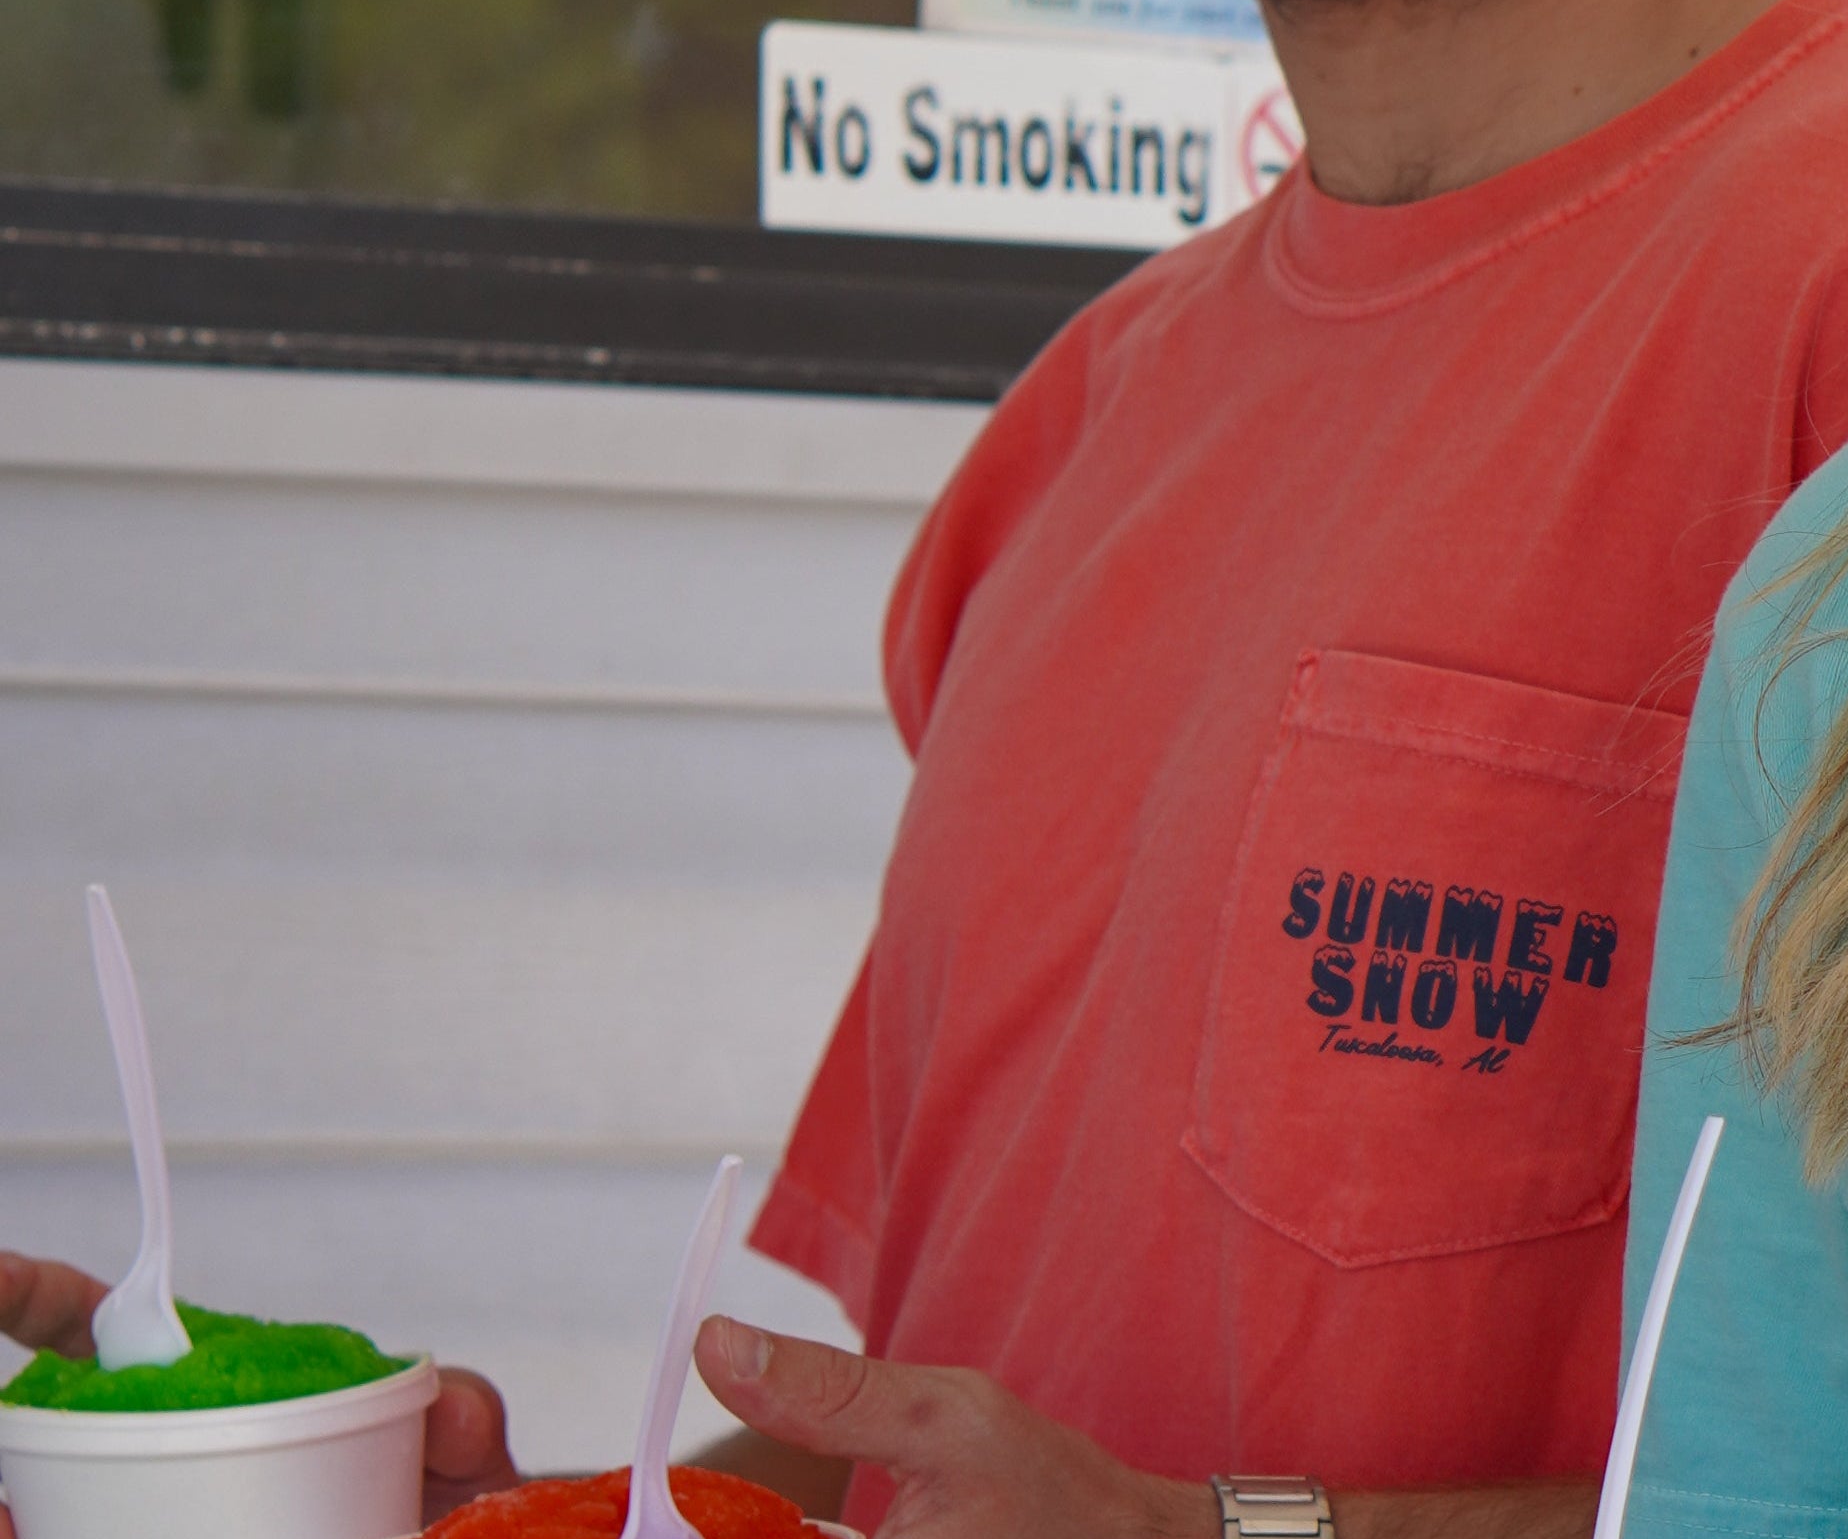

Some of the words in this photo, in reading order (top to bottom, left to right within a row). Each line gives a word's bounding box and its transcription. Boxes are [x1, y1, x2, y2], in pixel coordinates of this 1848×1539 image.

[780, 74, 871, 178] No
[903, 84, 1212, 226] Smoking
[1282, 867, 1618, 989] SUMMER
[1306, 944, 1550, 1046] SNOW
